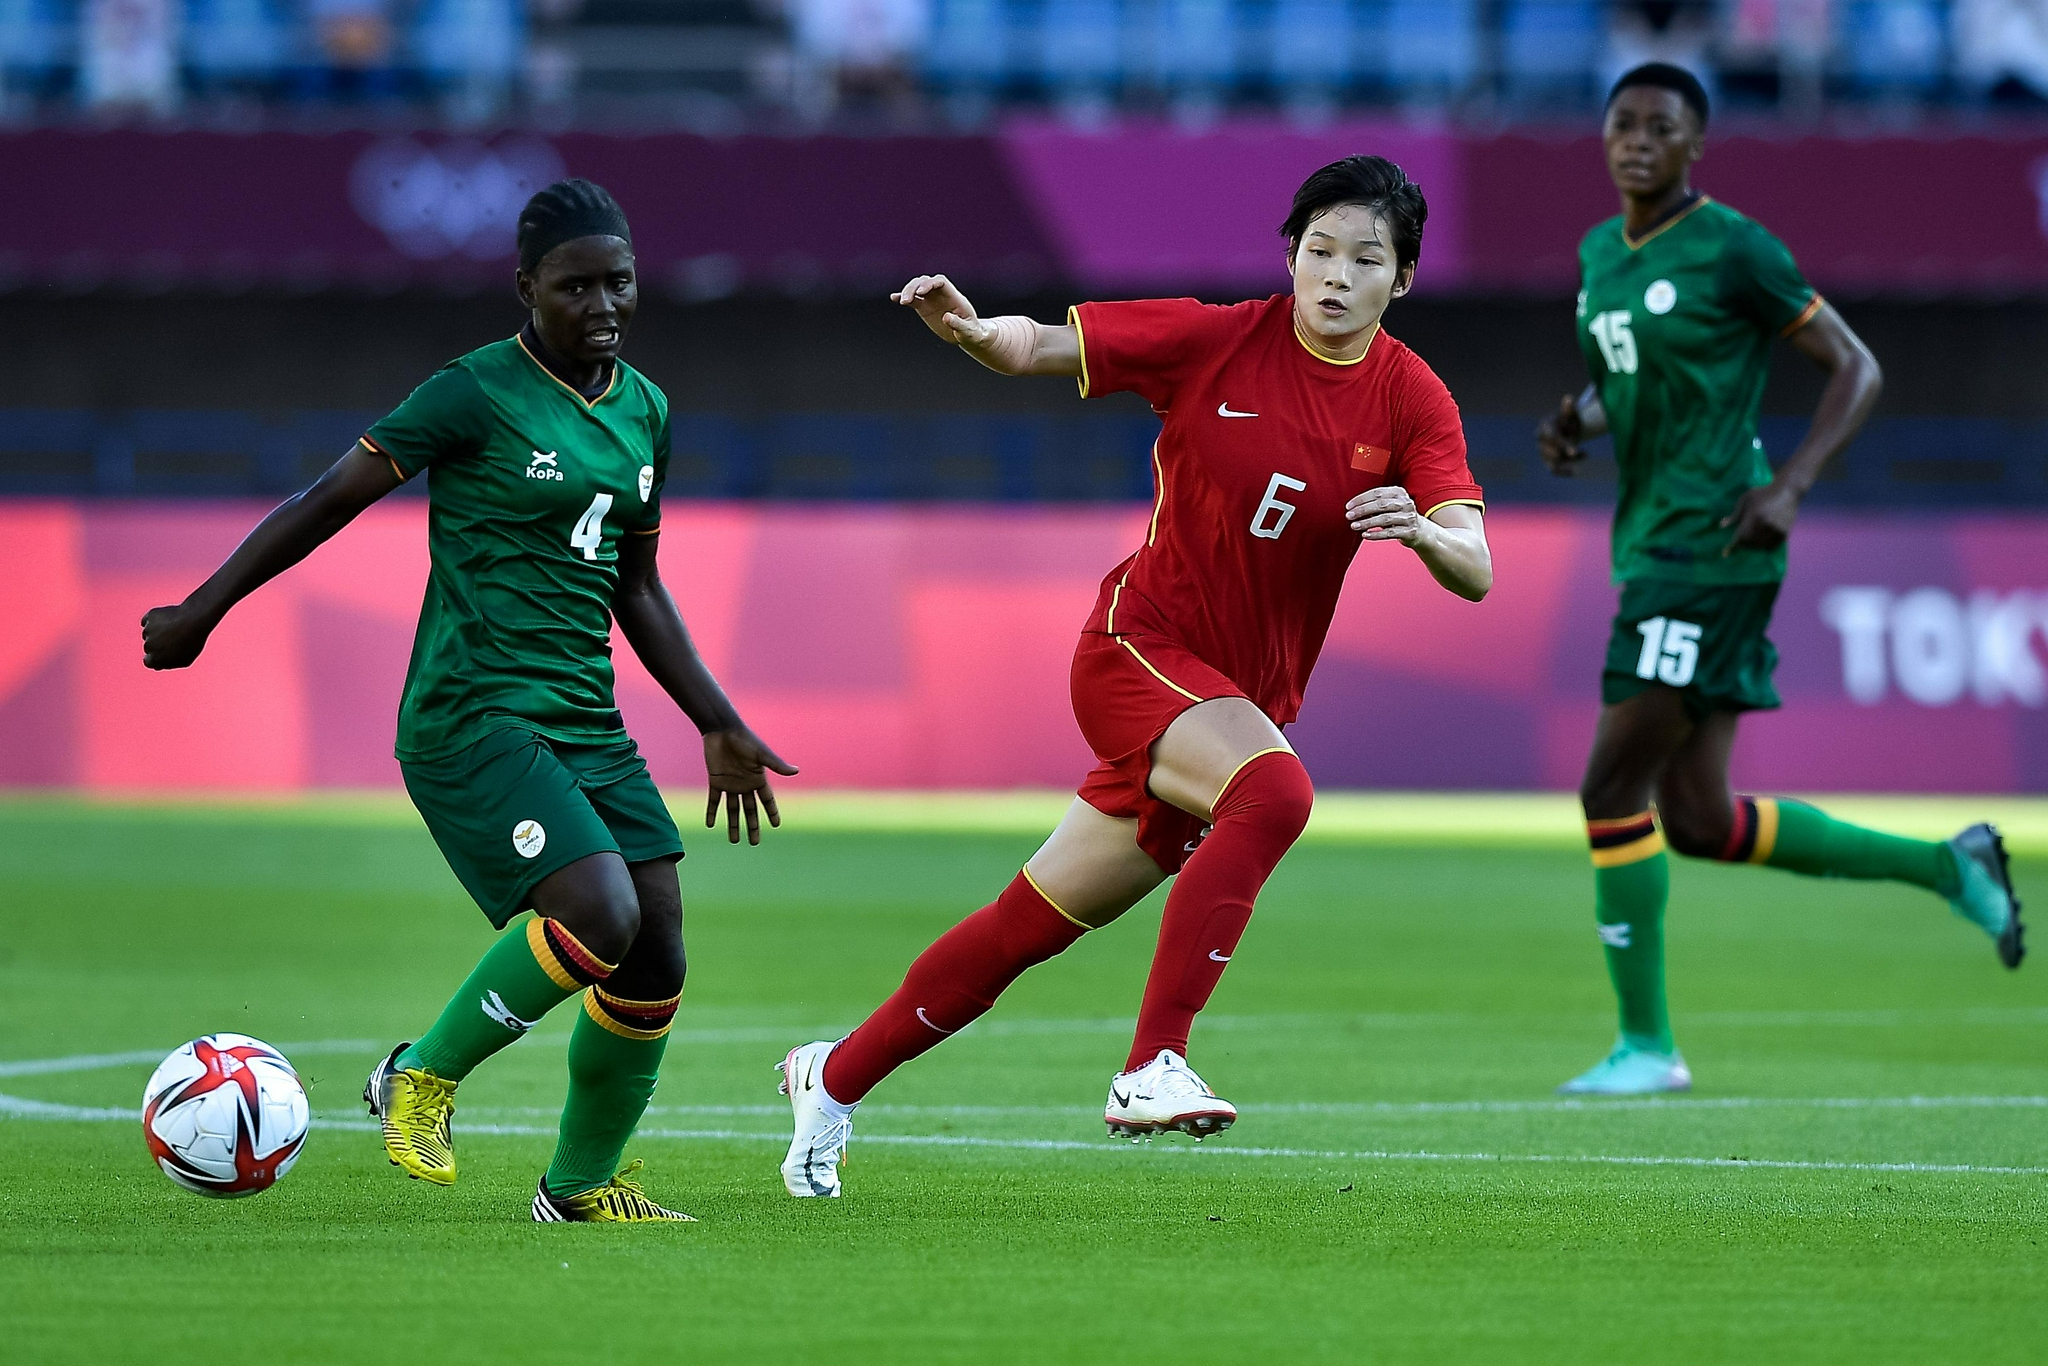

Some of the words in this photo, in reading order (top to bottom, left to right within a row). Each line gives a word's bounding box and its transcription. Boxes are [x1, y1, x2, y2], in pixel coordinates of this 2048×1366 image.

[1588, 309, 1638, 375] 15
[526, 466, 564, 481] KoPa
[1250, 472, 1307, 540] 6
[570, 493, 613, 560] 4
[1636, 615, 1703, 687] 15
[1820, 585, 2048, 707] TOK
